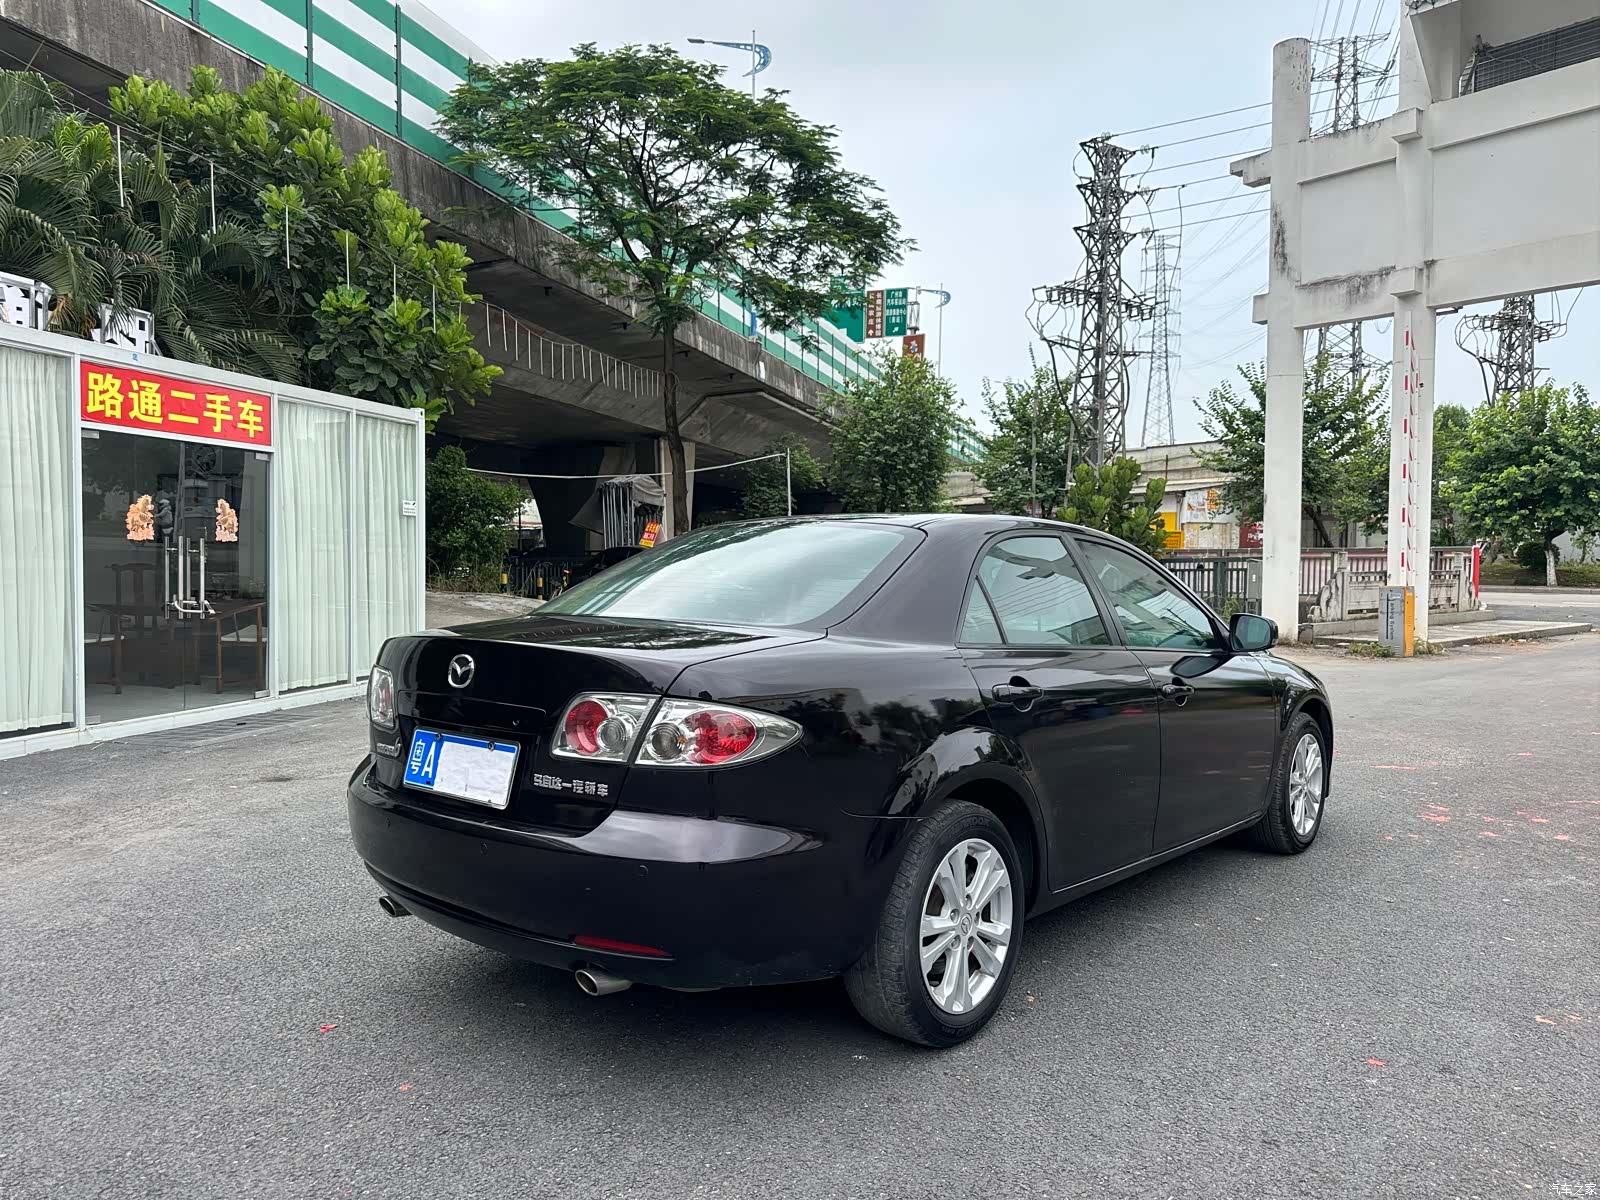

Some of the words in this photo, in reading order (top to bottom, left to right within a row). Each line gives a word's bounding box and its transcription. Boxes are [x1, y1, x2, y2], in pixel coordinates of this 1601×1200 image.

[87, 372, 264, 438] 路通二手车
[533, 773, 609, 797] 马自达一汽轿车
